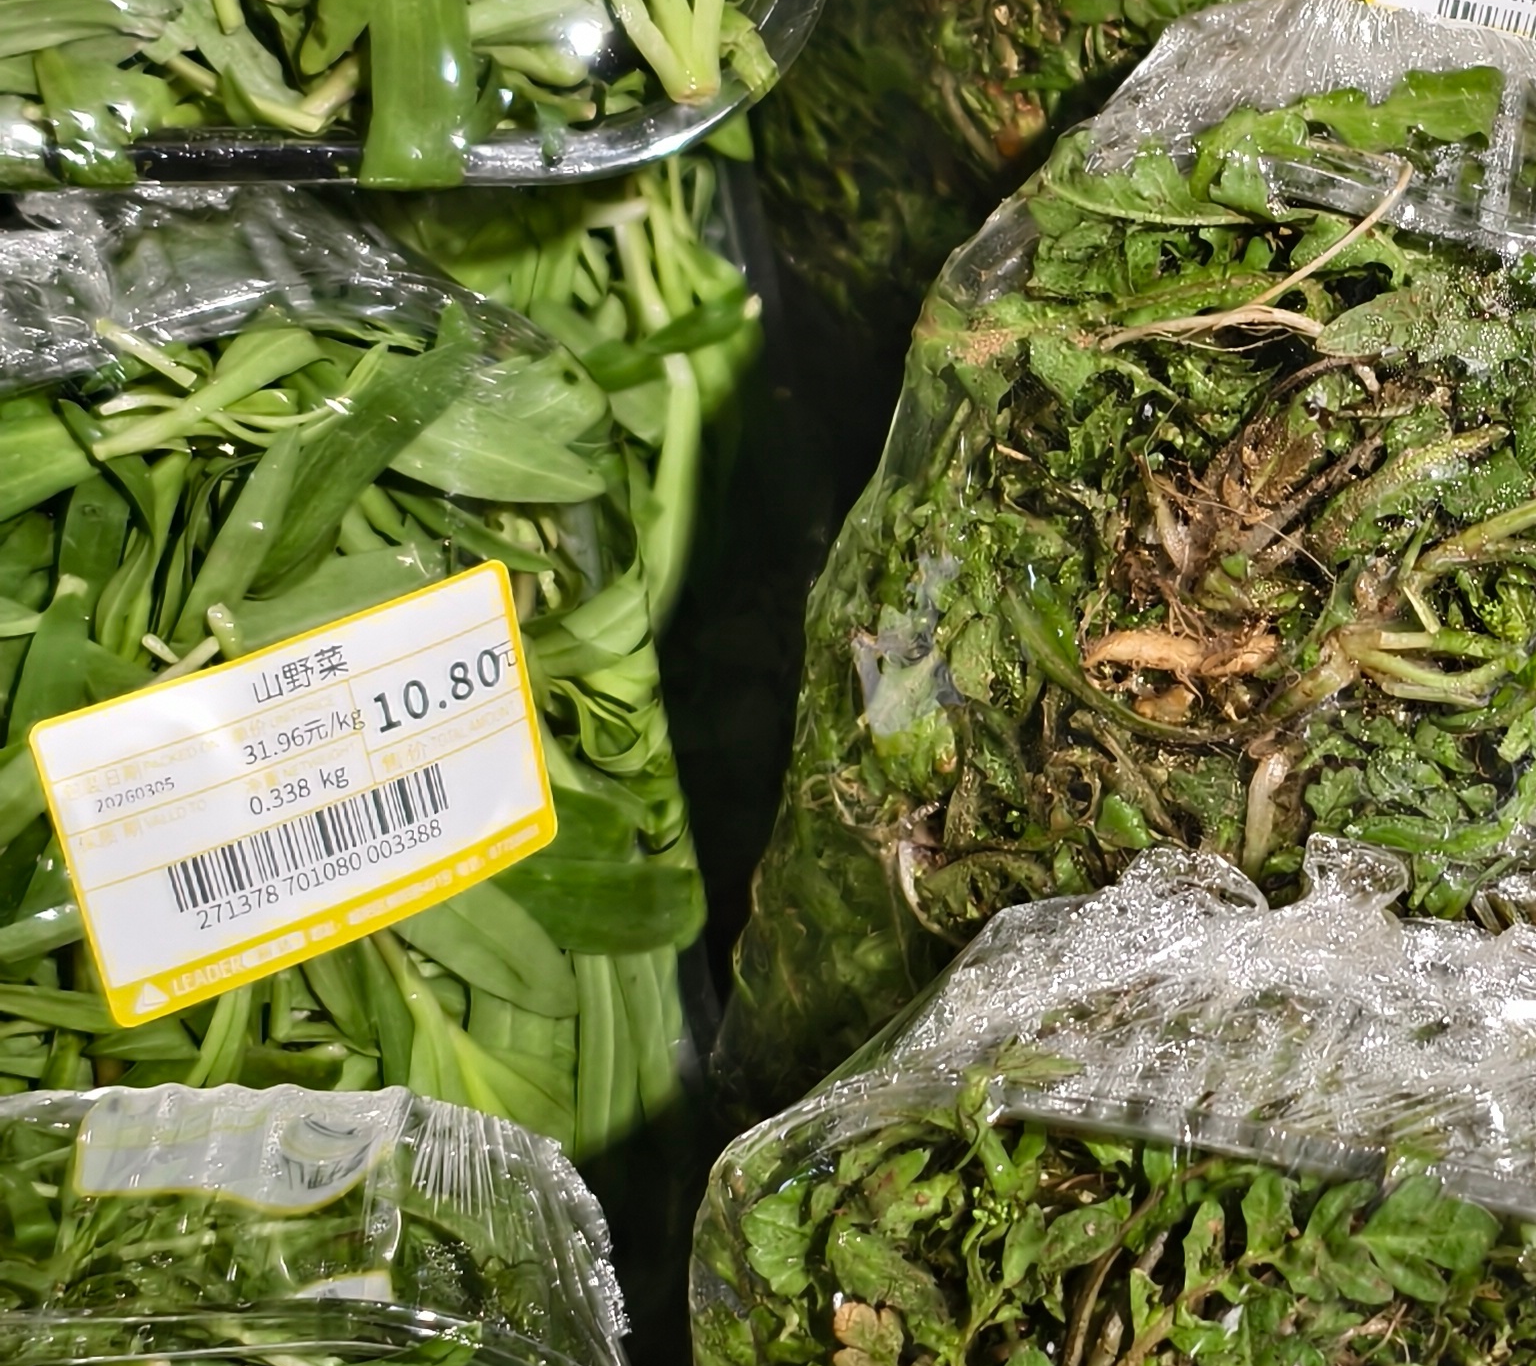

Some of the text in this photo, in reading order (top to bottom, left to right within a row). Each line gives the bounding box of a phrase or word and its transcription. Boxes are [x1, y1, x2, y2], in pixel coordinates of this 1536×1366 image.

[252, 645, 350, 704] 山野菜
[373, 648, 502, 734] 10.80
[243, 707, 366, 765] 31.96元/kg
[250, 777, 312, 817] 0.338
[320, 765, 350, 797] kg
[197, 886, 280, 930] 271378
[283, 851, 362, 896] 701080
[367, 819, 443, 865] 003388
